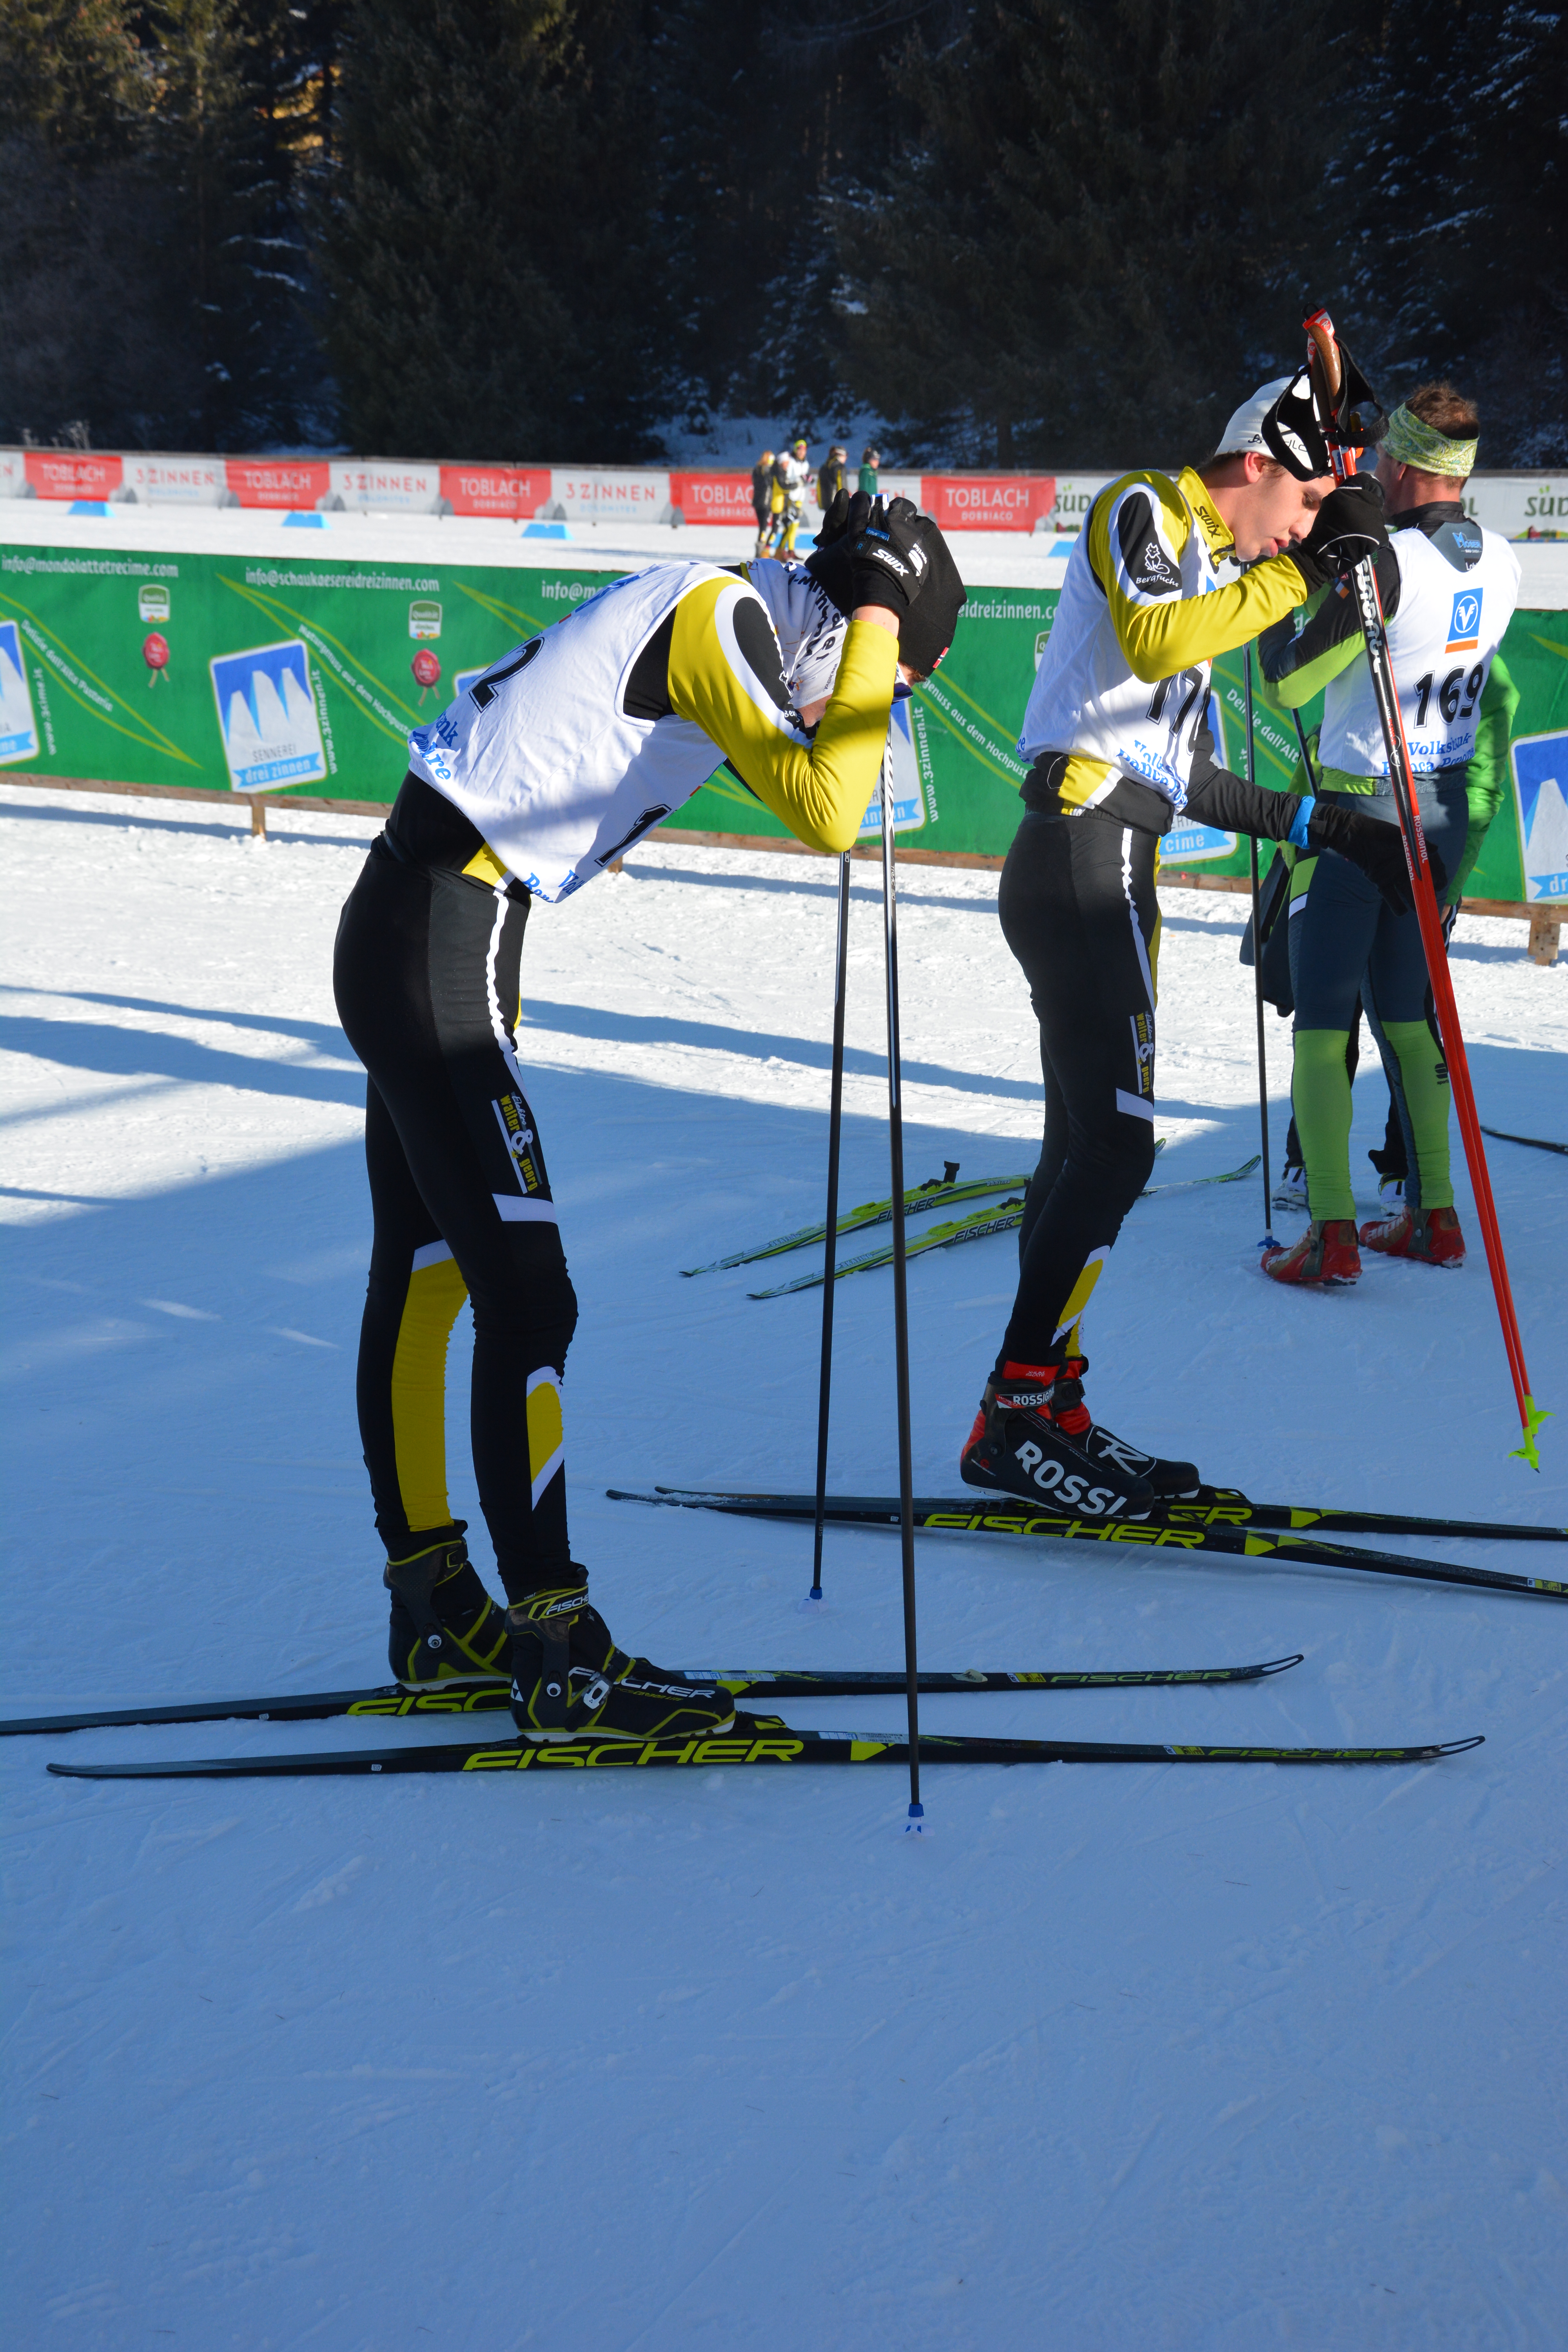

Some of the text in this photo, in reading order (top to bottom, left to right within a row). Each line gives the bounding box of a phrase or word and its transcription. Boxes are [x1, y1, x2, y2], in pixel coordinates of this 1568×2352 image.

[42, 463, 105, 482] TOBLACH
[136, 468, 214, 486] 3 ZINNEN
[244, 470, 311, 489] TOBLACH
[343, 474, 426, 492] 3 ZINNEN
[459, 477, 530, 497] TOBLACH
[566, 482, 656, 501] 3 ZINNEN
[473, 498, 517, 510] DOBBIACO
[946, 488, 1029, 508] TOBLACH
[961, 511, 1013, 522] DOBBIACO
[246, 567, 440, 592] info@schaukaesereidreizinnen.com
[1136, 574, 1179, 587] Bergfuchs
[1414, 662, 1485, 729] 169
[950, 708, 967, 727] aus
[966, 724, 986, 745] dem
[252, 744, 297, 763] SENNEREI
[1260, 725, 1299, 764] dall'Alt
[1408, 733, 1472, 755] Volksbank
[246, 758, 311, 784] drei zinnen
[913, 706, 939, 823] www.3zinnen.it
[1165, 832, 1205, 852] cime
[1413, 814, 1428, 864] ROSSIGNOL
[1139, 1043, 1154, 1062] &
[511, 1096, 526, 1125] Elektro
[511, 1129, 533, 1155] &
[877, 1196, 936, 1224] FICHER
[769, 1232, 801, 1247] SKATING
[954, 1216, 1017, 1243] FISCHER
[840, 1252, 874, 1268] SKATING
[1015, 1440, 1127, 1516] ROSSI
[924, 1514, 1205, 1549] FISCHER
[568, 1666, 716, 1699] FICHER
[1050, 1671, 1231, 1683] FISCHER
[463, 1739, 804, 1771] FISCHER
[1208, 1749, 1406, 1759] FISCHER
